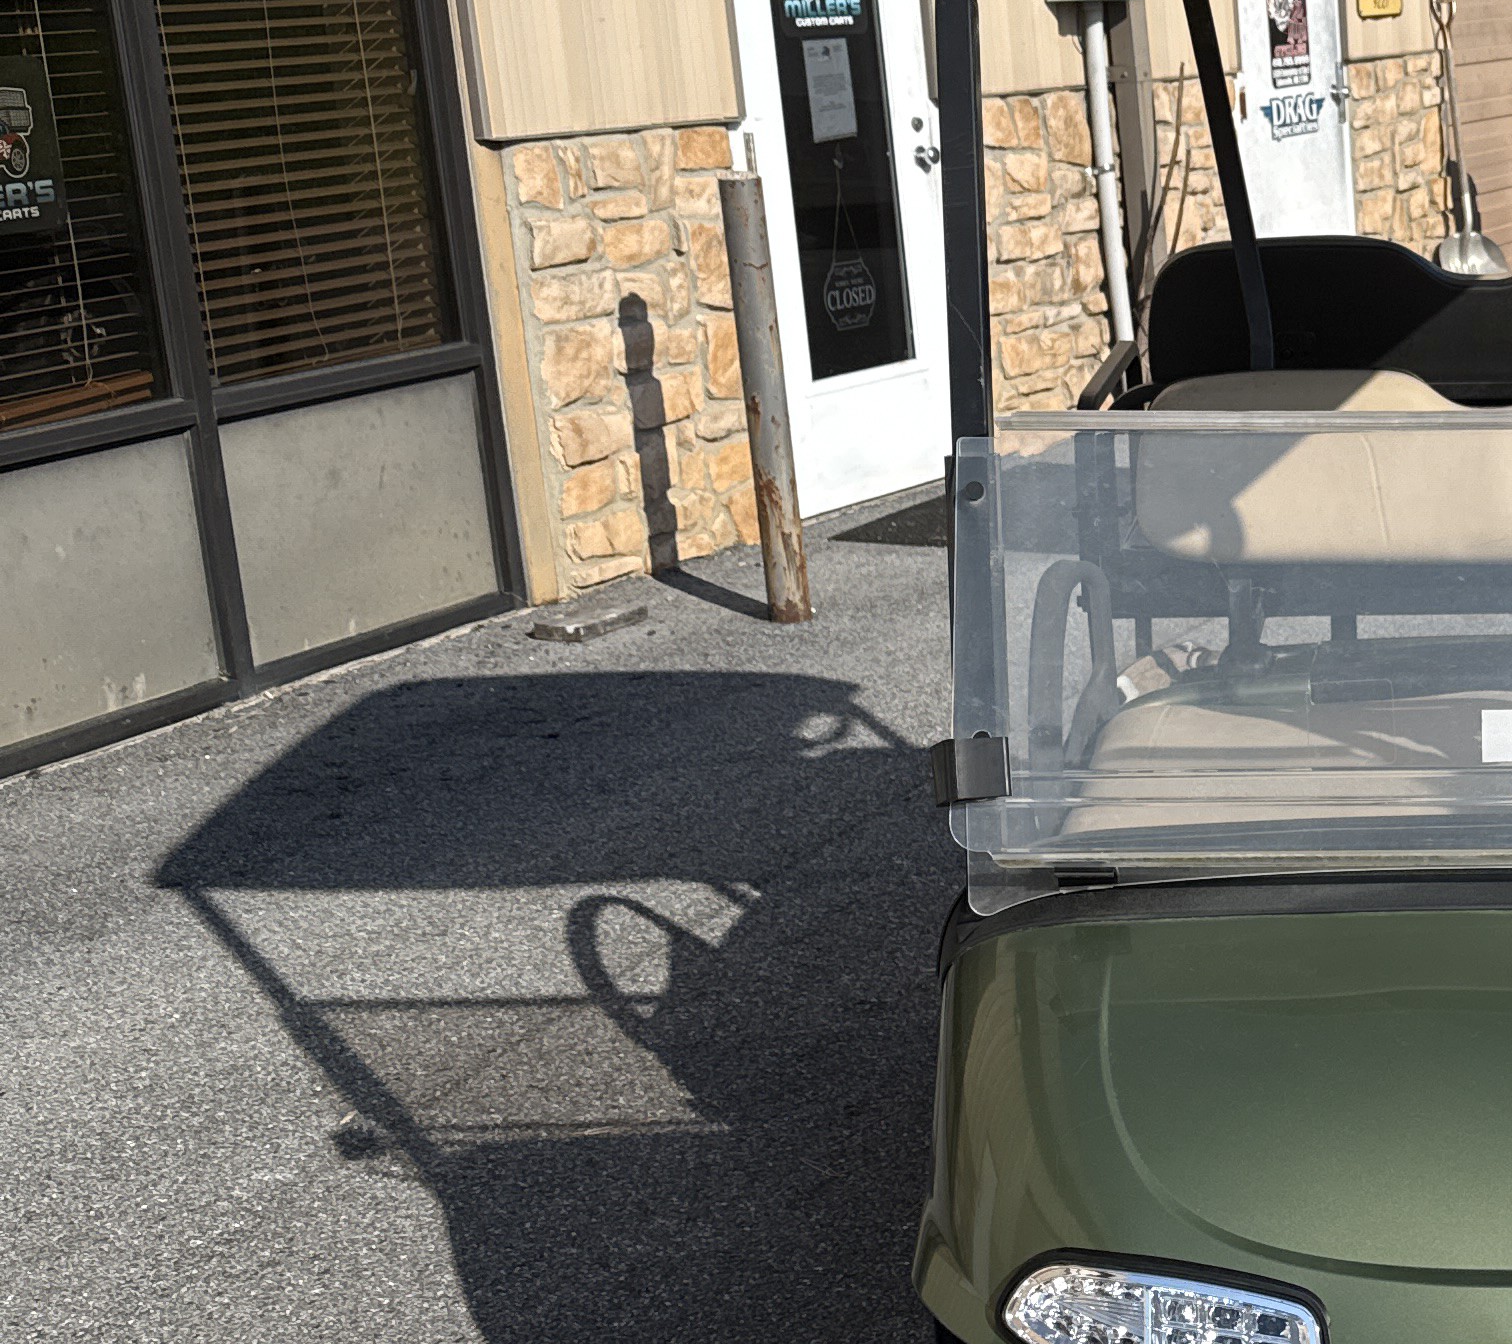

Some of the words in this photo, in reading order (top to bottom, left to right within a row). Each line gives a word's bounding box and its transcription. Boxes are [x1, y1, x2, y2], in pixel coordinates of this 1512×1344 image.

[795, 16, 829, 28] CUSTOM
[829, 15, 854, 26] CARTS
[1270, 92, 1318, 126] DRAG
[827, 285, 874, 311] CLOSED
